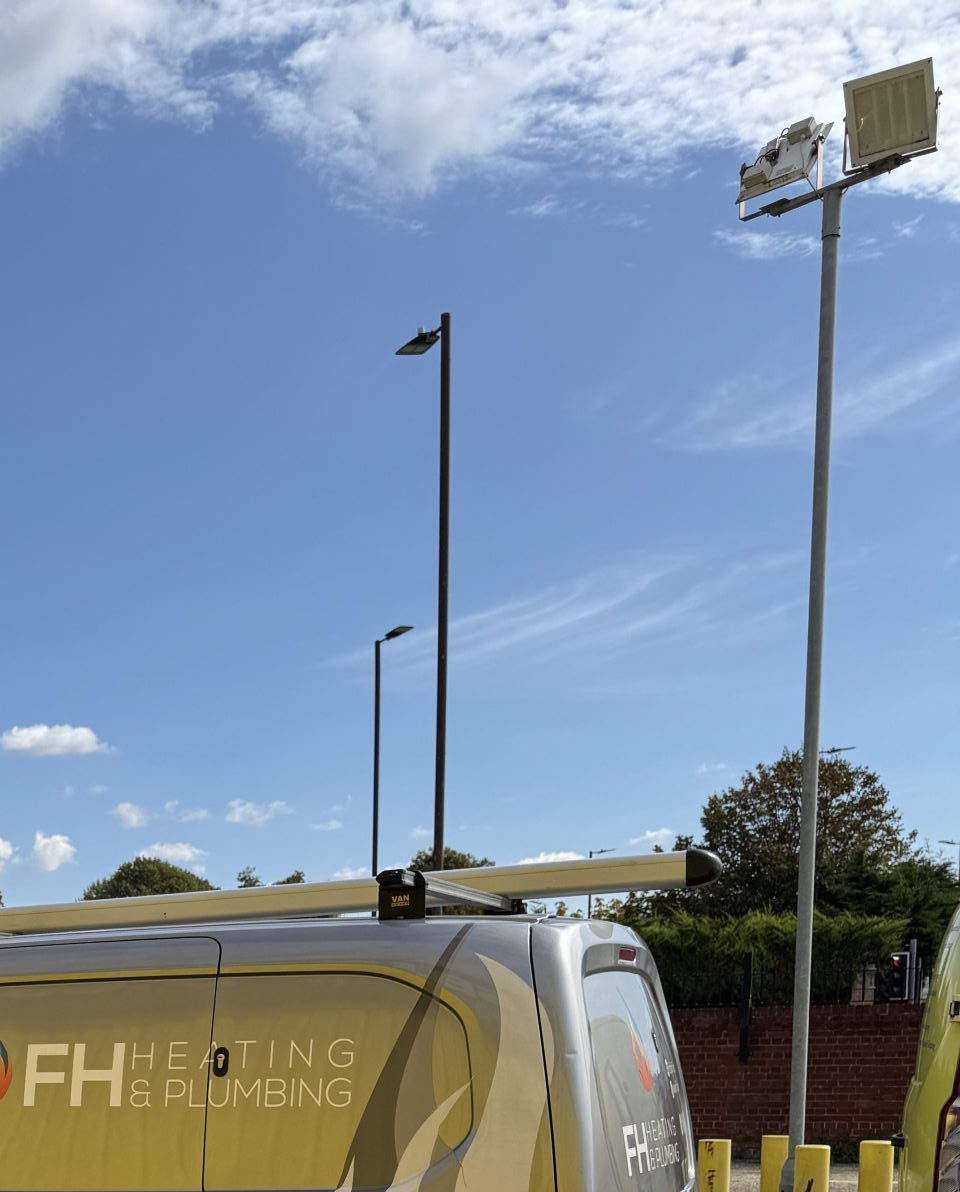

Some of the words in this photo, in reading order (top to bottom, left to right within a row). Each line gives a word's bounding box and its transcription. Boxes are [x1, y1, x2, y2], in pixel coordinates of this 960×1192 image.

[391, 894, 410, 903] VAN
[131, 1038, 355, 1071] HEATING
[23, 1042, 126, 1107] FH
[129, 1079, 151, 1108] &
[164, 1077, 353, 1108] PLUMBING
[645, 1116, 677, 1142] HEATING
[622, 1122, 651, 1177] FH
[655, 1142, 680, 1168] PLUMBING
